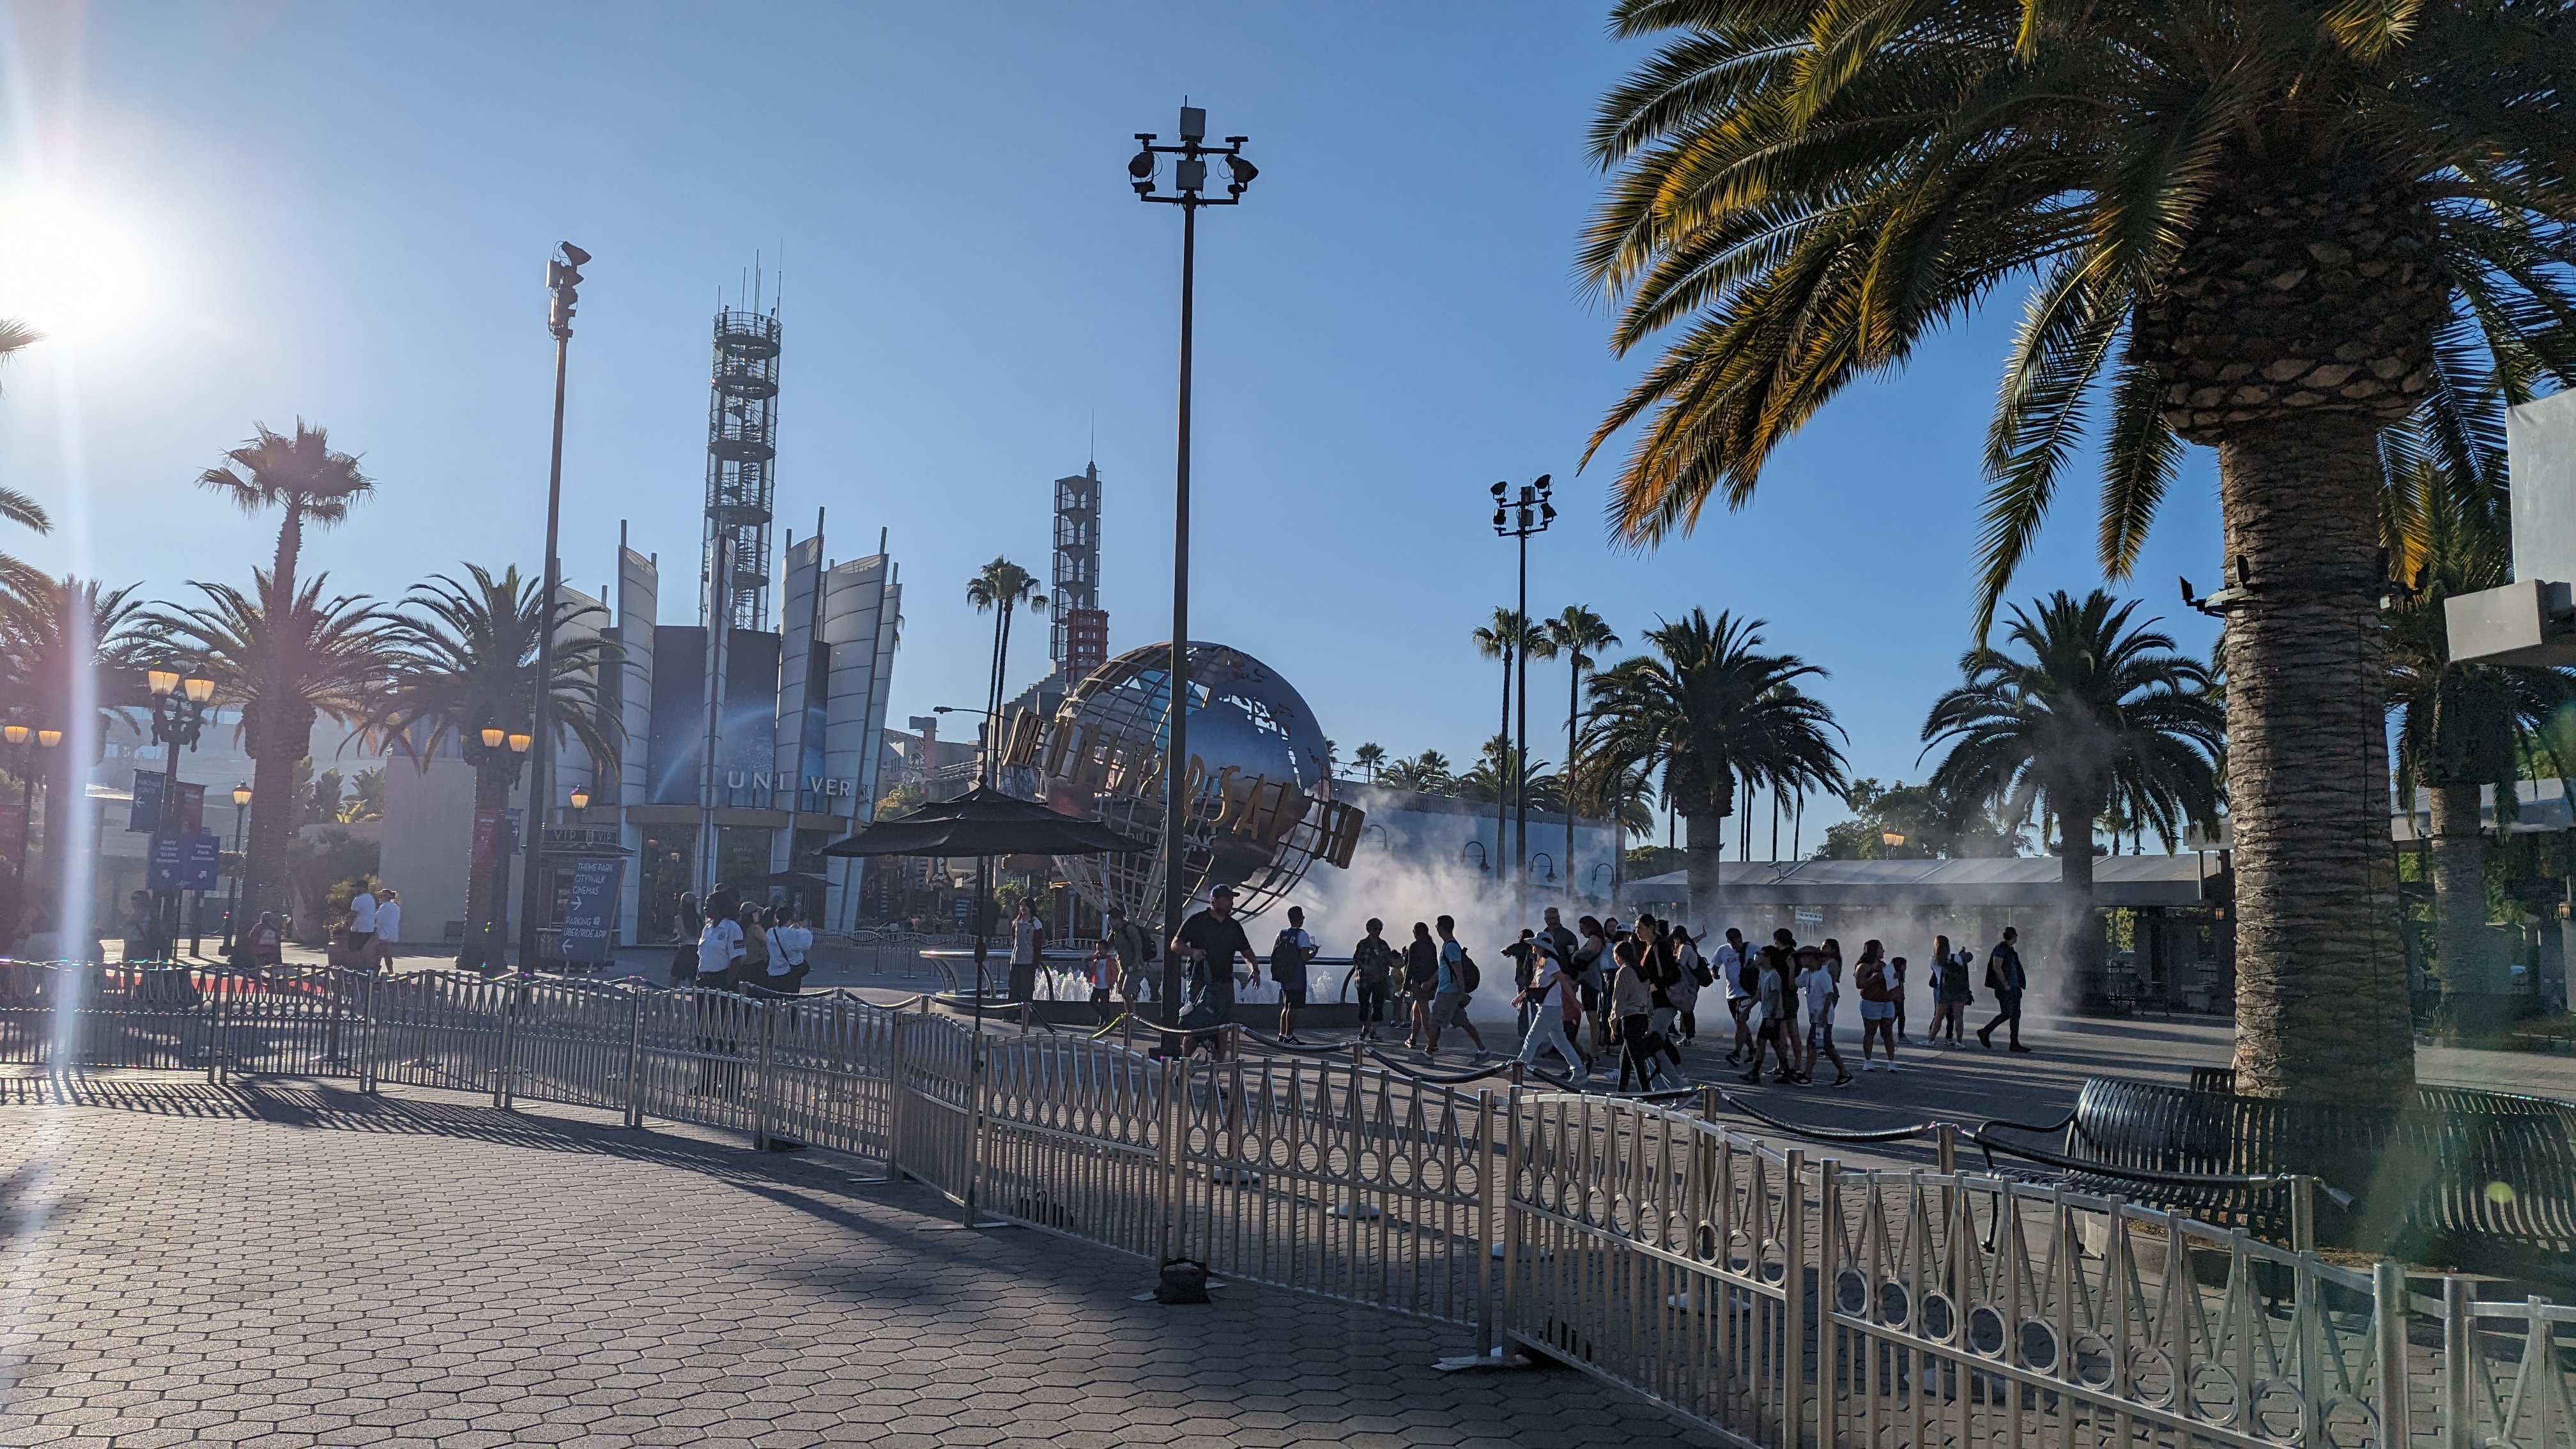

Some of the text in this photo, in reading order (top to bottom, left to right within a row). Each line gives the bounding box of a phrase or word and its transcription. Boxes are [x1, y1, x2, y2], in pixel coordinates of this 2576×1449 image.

[554, 830, 576, 841] VIP
[598, 832, 611, 842] VIP
[578, 862, 613, 872] THEME PARK
[575, 874, 606, 884] CITYWALK
[572, 885, 599, 895] CINEMAS
[565, 917, 592, 926] PARKING
[564, 928, 607, 939] UBER/RIDE APP
